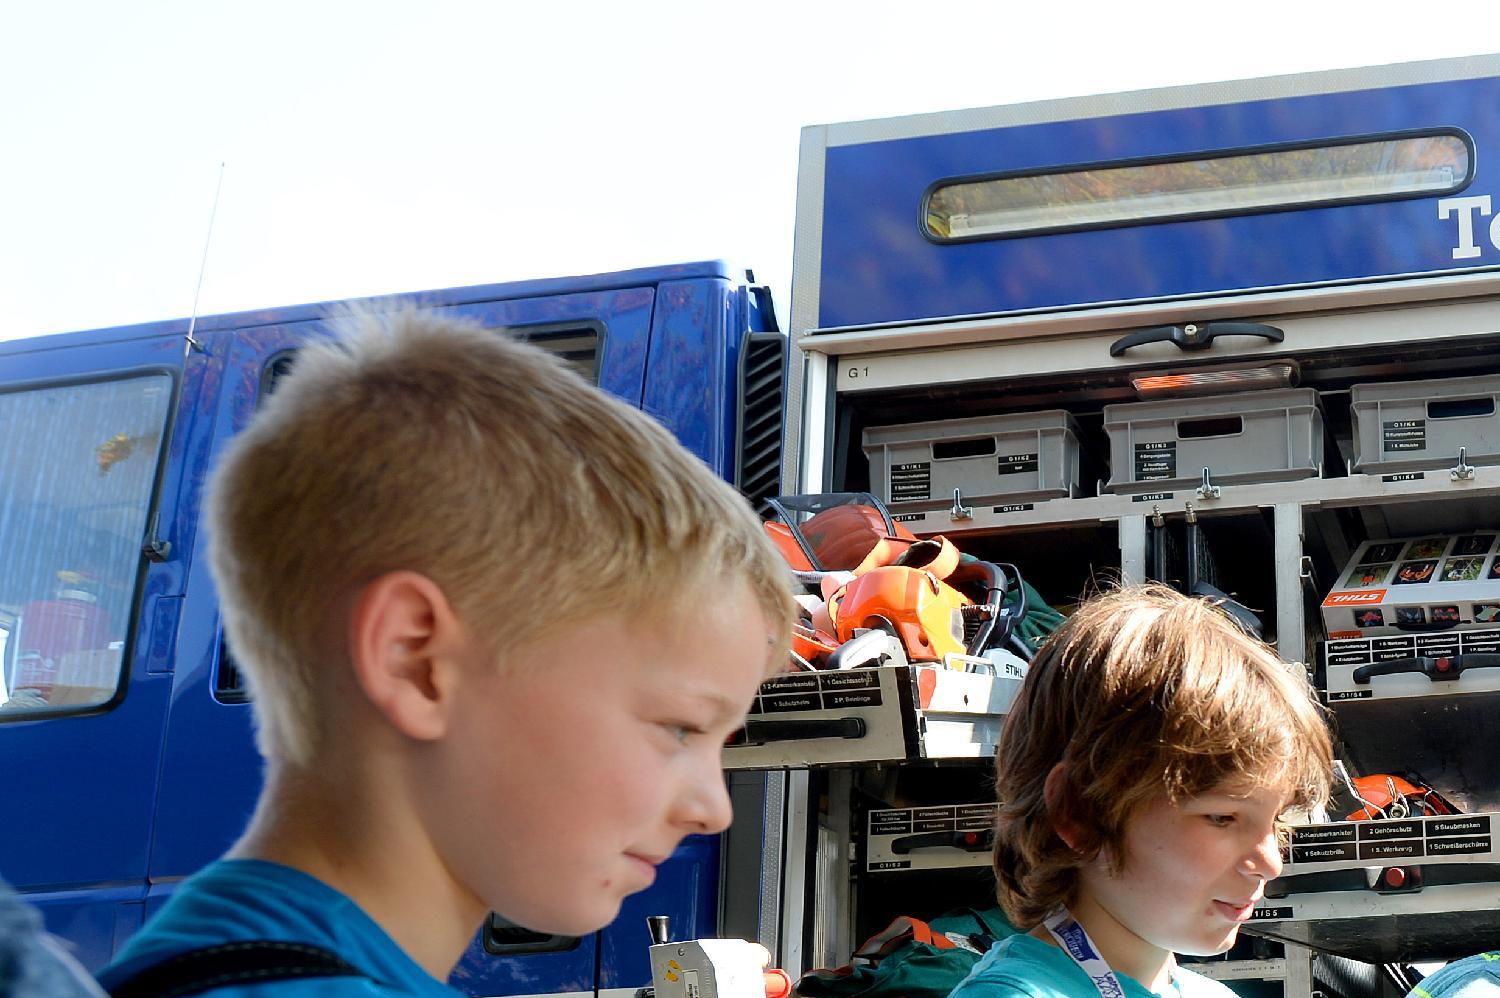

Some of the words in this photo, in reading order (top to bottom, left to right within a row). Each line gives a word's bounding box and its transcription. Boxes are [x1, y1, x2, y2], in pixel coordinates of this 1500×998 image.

[848, 367, 859, 378] G
[1333, 593, 1382, 602] STIHL
[1005, 663, 1024, 678] STIHL
